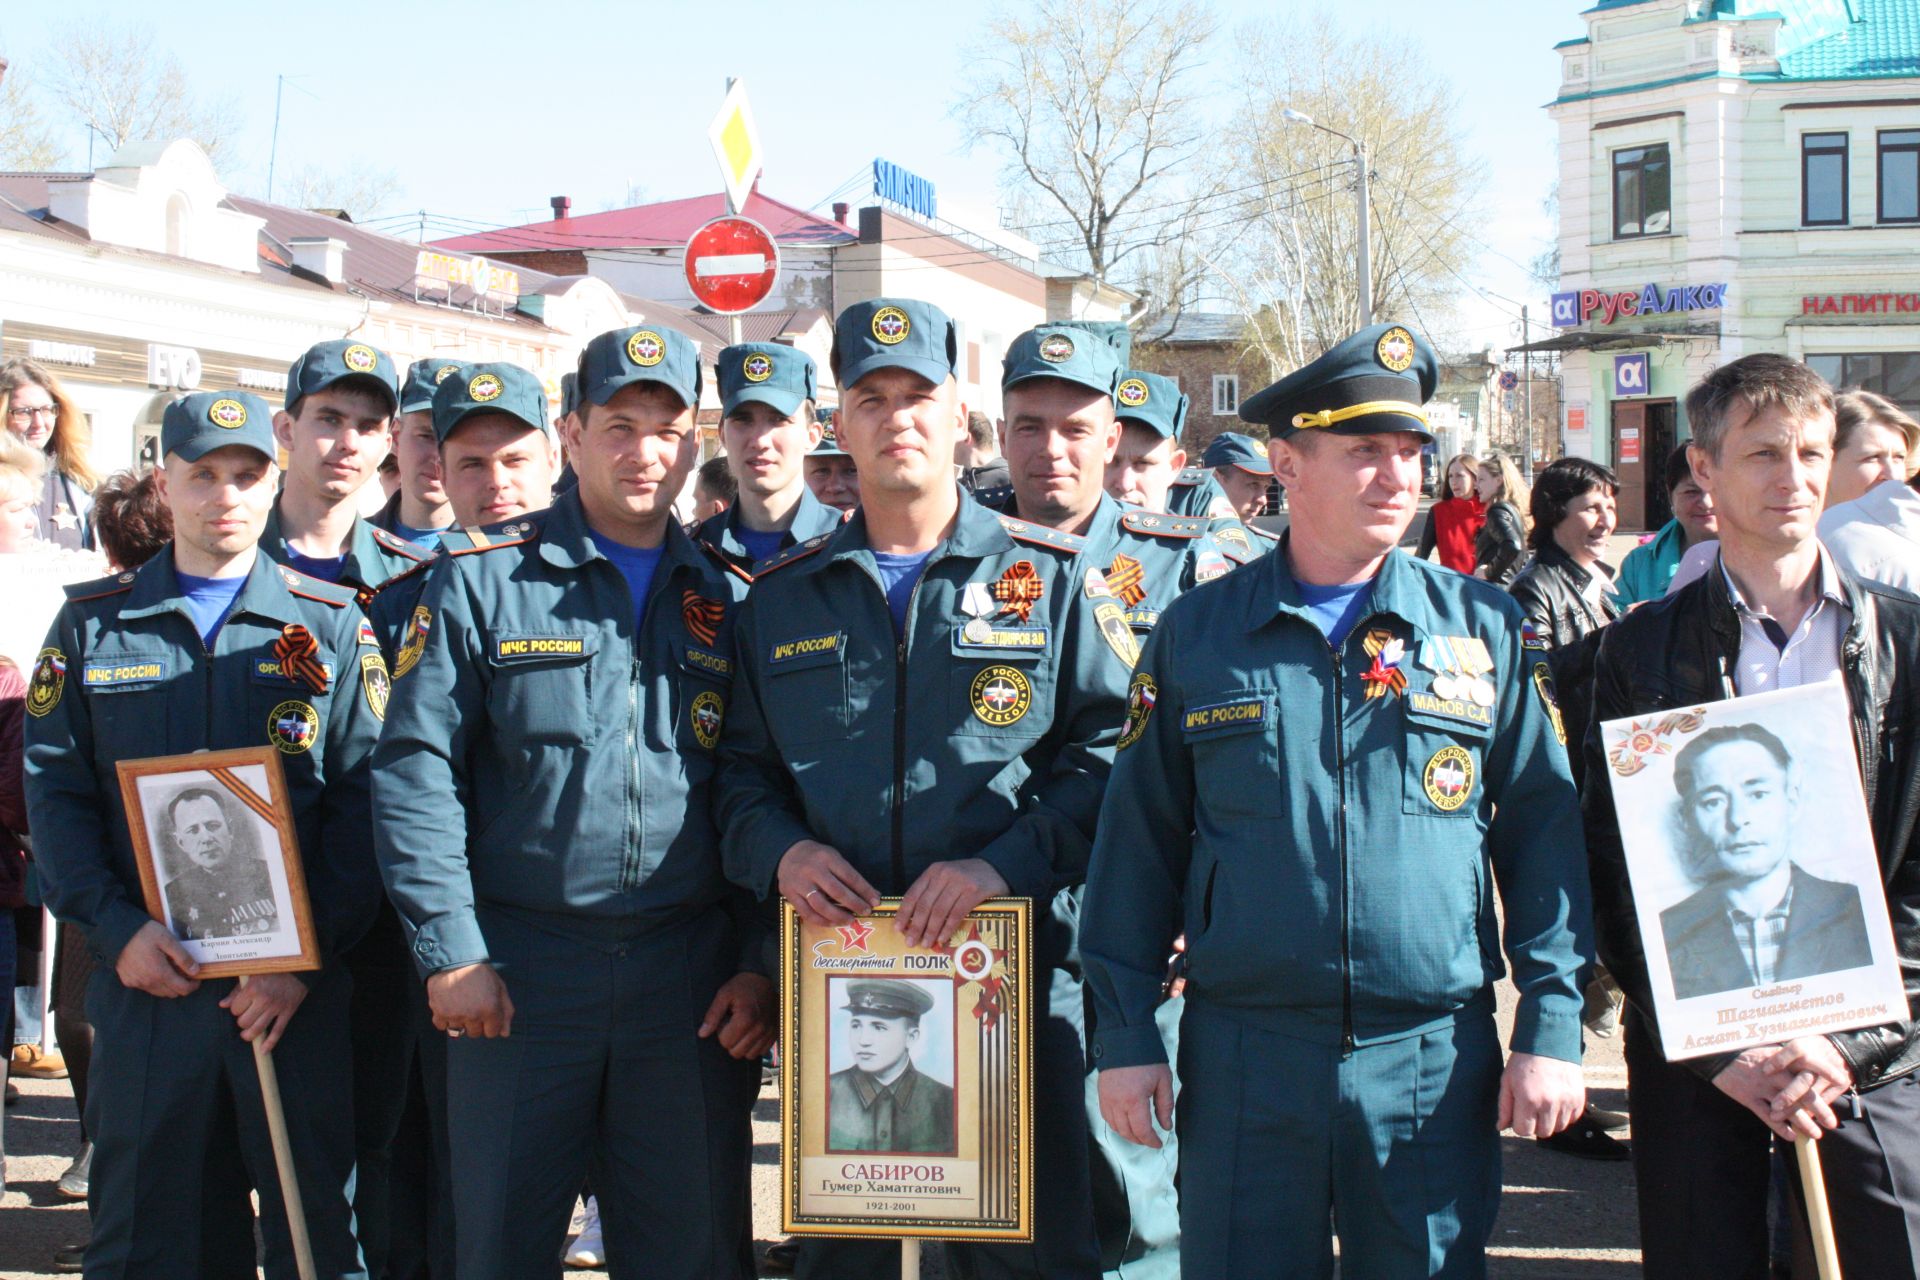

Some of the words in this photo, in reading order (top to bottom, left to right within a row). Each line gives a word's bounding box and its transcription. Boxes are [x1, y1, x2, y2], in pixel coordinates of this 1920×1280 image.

[873, 157, 937, 219] SAMSUNG
[148, 344, 201, 390] EVO
[501, 641, 528, 655] МЧС
[531, 639, 582, 652] РОССИИ
[774, 643, 795, 659] МЧС
[796, 635, 837, 654] РОССИИ
[87, 669, 112, 682] МЧС
[115, 664, 161, 680] РОССИИ
[975, 672, 991, 690] МЧС
[992, 668, 1026, 691] РОССИИ
[974, 699, 1026, 722] EMERCOM
[1186, 710, 1209, 728] МЧС
[1212, 703, 1261, 723] РОССИИ
[1413, 694, 1465, 716] МАНОВ
[1448, 748, 1471, 775] РОССИИ
[904, 955, 950, 969] ПОЛК
[841, 1163, 946, 1182] САБИРОВ
[822, 1180, 863, 1194] Гумер
[866, 1181, 961, 1194] Хаматгатович
[866, 1201, 917, 1211] 1921-2001
